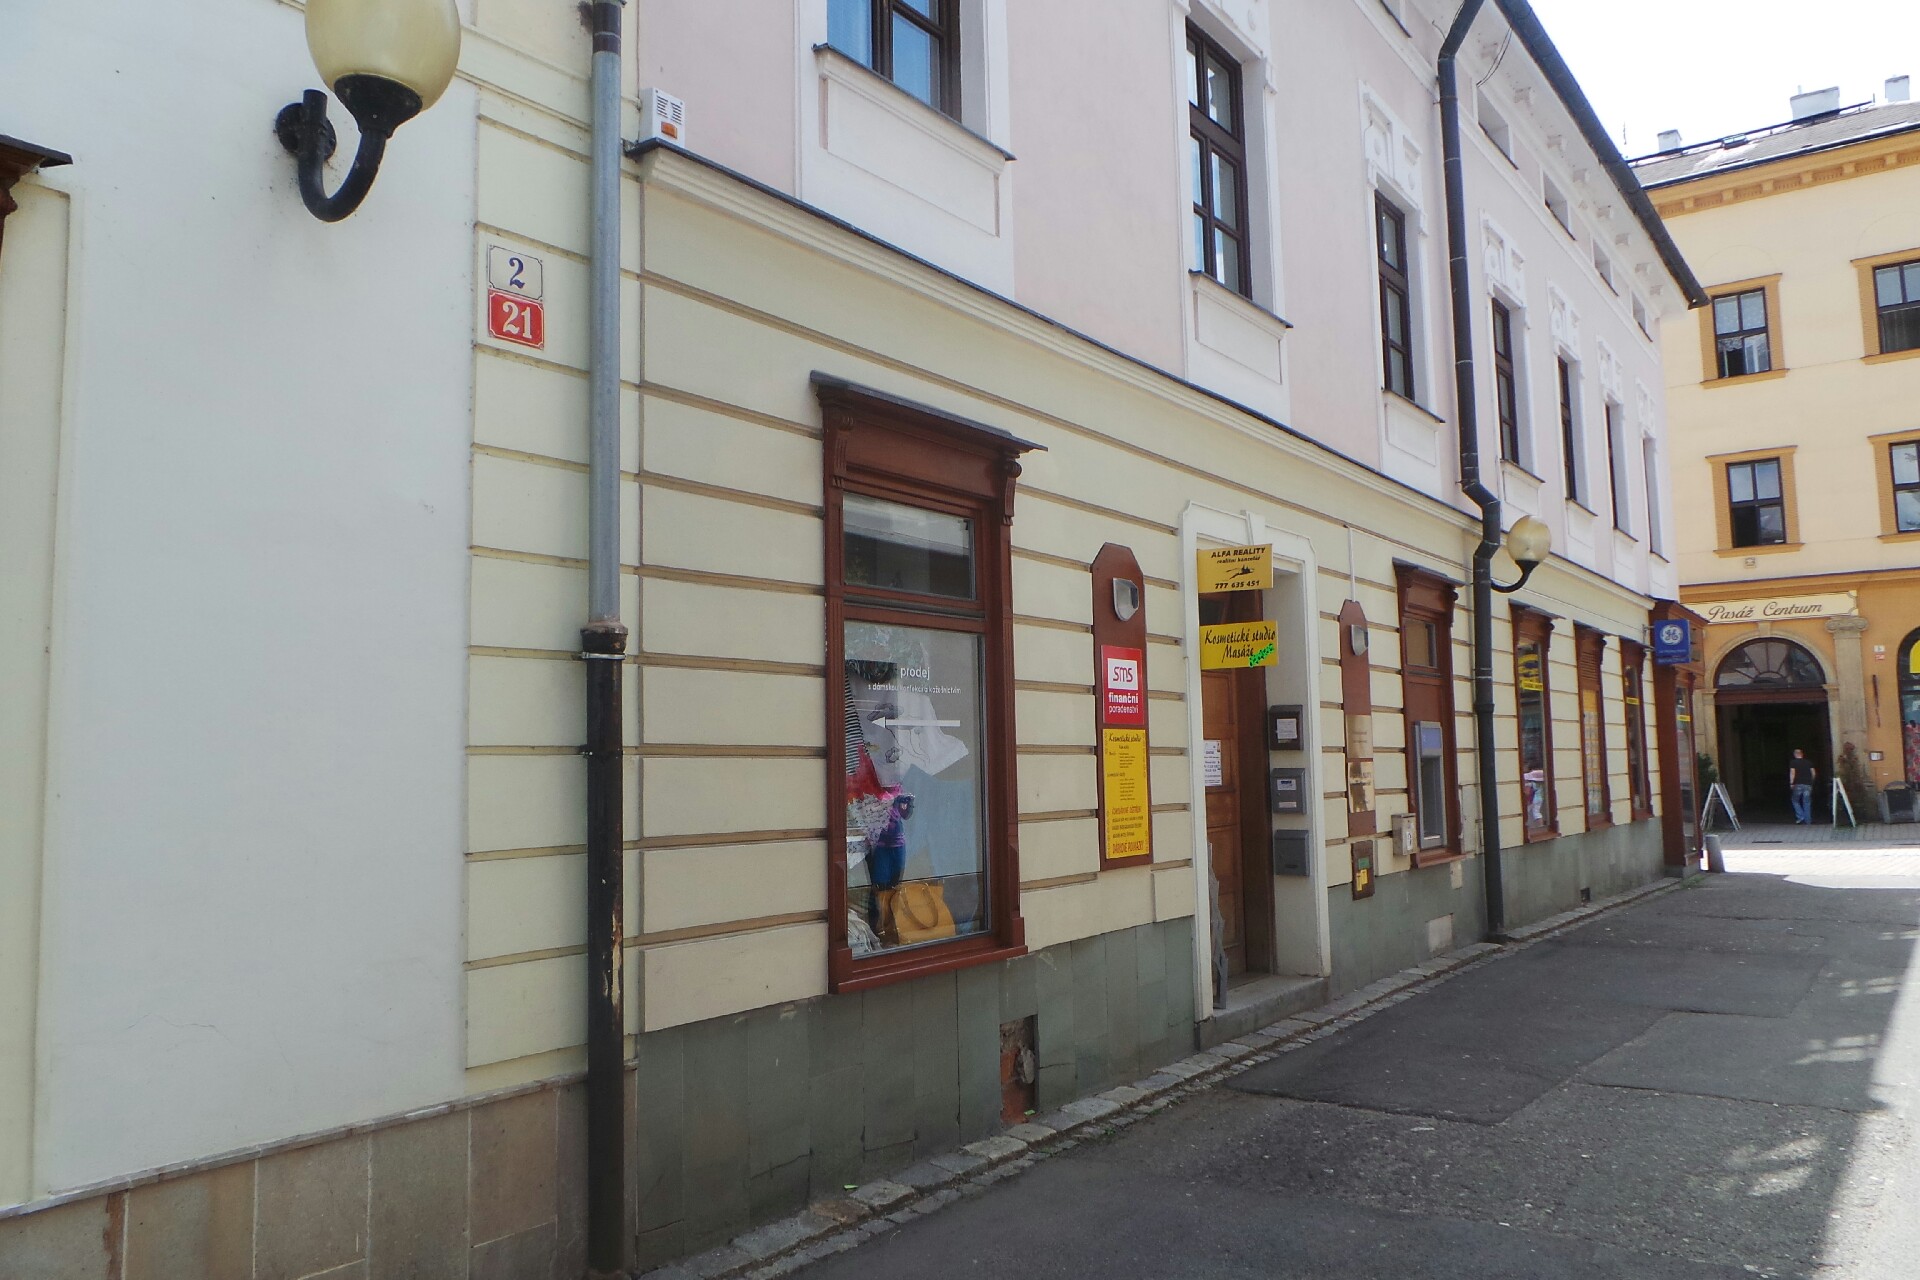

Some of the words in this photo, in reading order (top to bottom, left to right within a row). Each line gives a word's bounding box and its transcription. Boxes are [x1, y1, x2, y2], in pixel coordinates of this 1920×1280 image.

[508, 257, 526, 289] 2
[502, 301, 532, 339] 21
[1211, 550, 1231, 559] ALFA
[1233, 547, 1266, 556] REALITY
[1708, 605, 1754, 620] Pasáž
[1763, 602, 1823, 616] Centrum
[1205, 628, 1251, 644] Kosmetické
[1252, 626, 1276, 642] studio
[1221, 643, 1255, 663] Masáže
[900, 666, 931, 681] prodej
[1109, 692, 1139, 704] finanční
